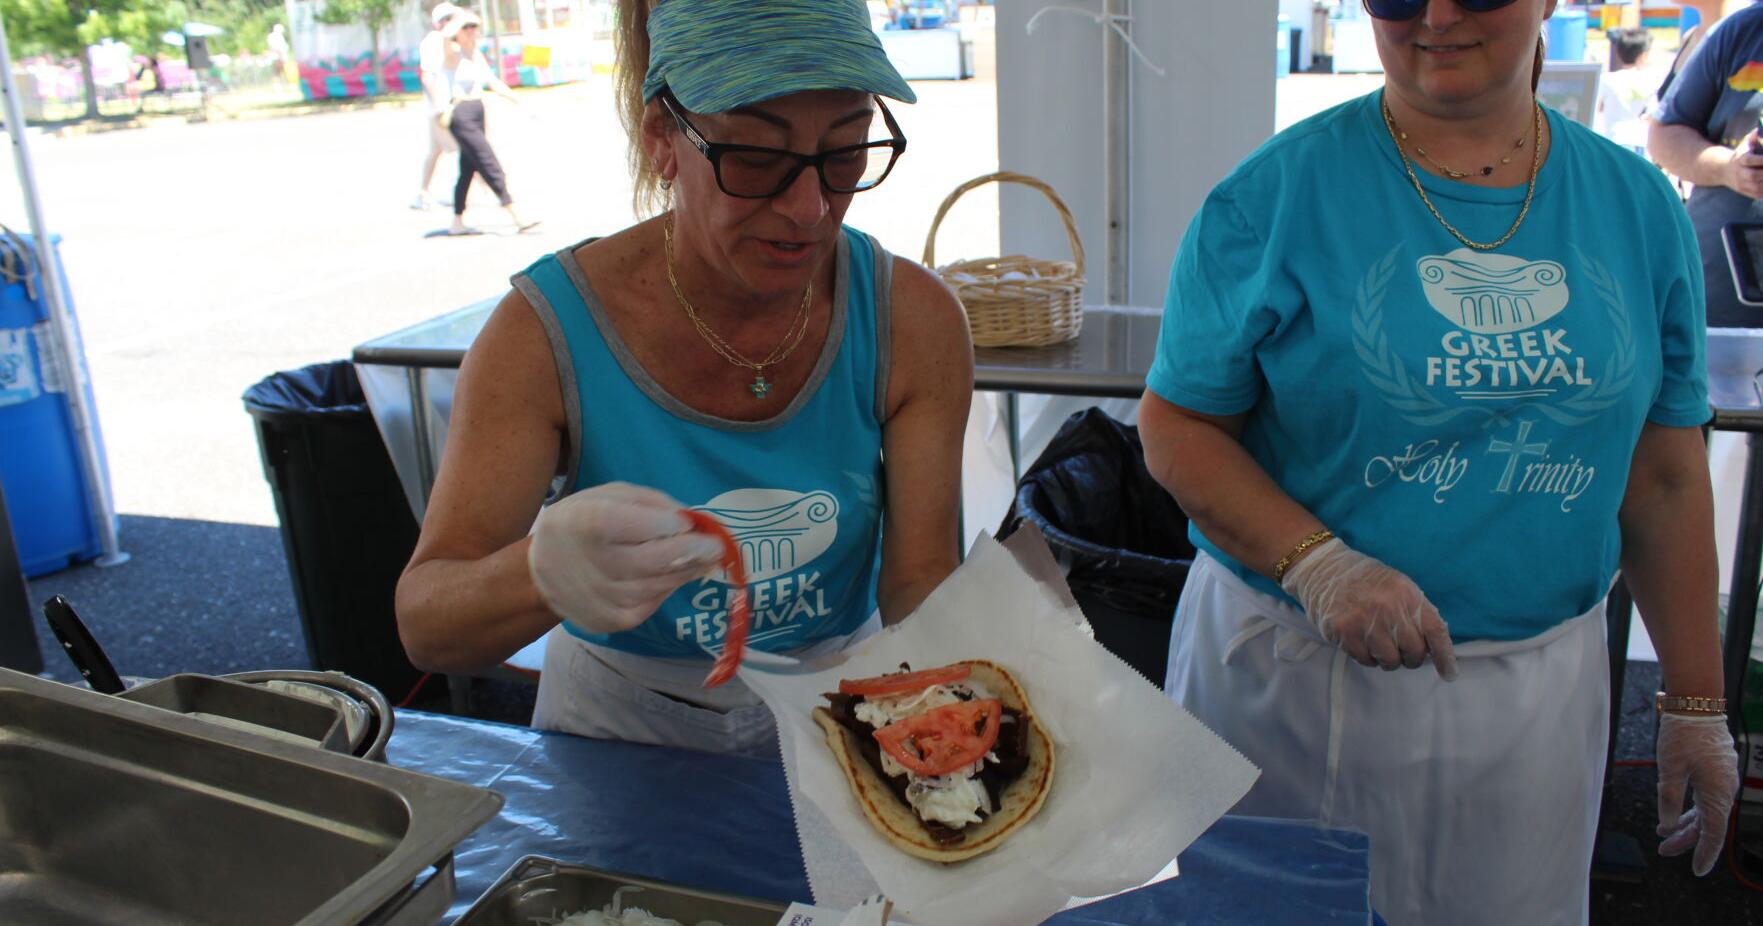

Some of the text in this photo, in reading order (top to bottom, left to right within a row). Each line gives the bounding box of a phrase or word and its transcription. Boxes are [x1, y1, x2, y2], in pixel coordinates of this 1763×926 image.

[1441, 329, 1571, 358] GREEK
[1426, 357, 1592, 386] FESTIVAL
[1365, 440, 1468, 503] Holy
[676, 589, 832, 644] FESIVAL
